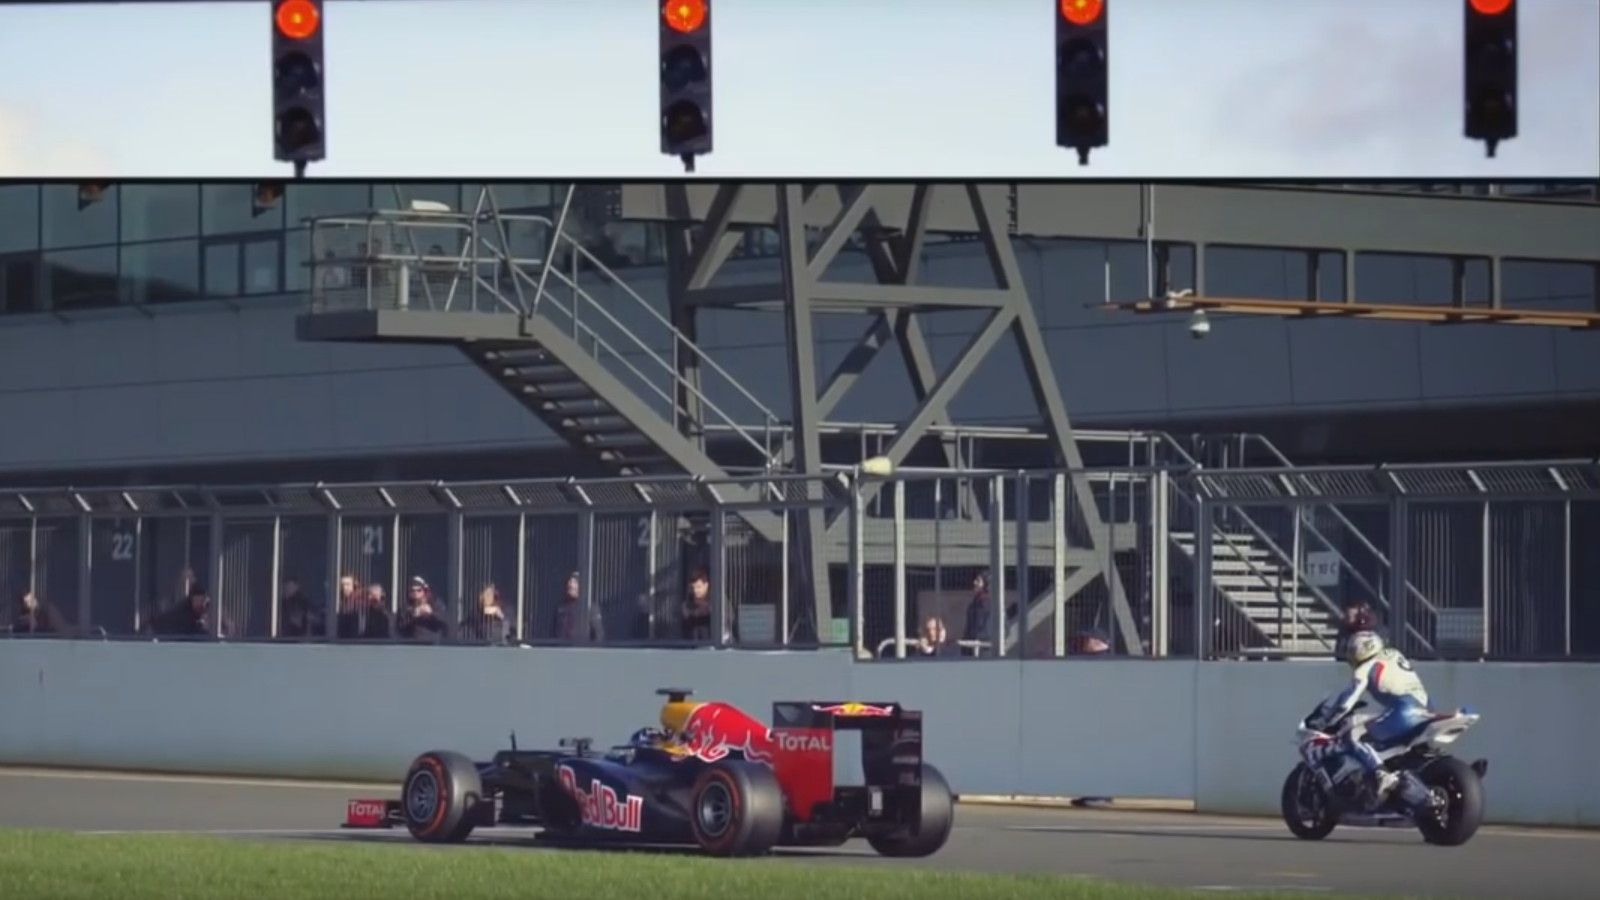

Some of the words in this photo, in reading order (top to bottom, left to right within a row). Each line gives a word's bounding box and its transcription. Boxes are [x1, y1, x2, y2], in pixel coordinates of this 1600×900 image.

[112, 533, 133, 560] 22
[364, 526, 383, 554] 21
[776, 732, 831, 751] TOTAL
[601, 785, 643, 832] Bull
